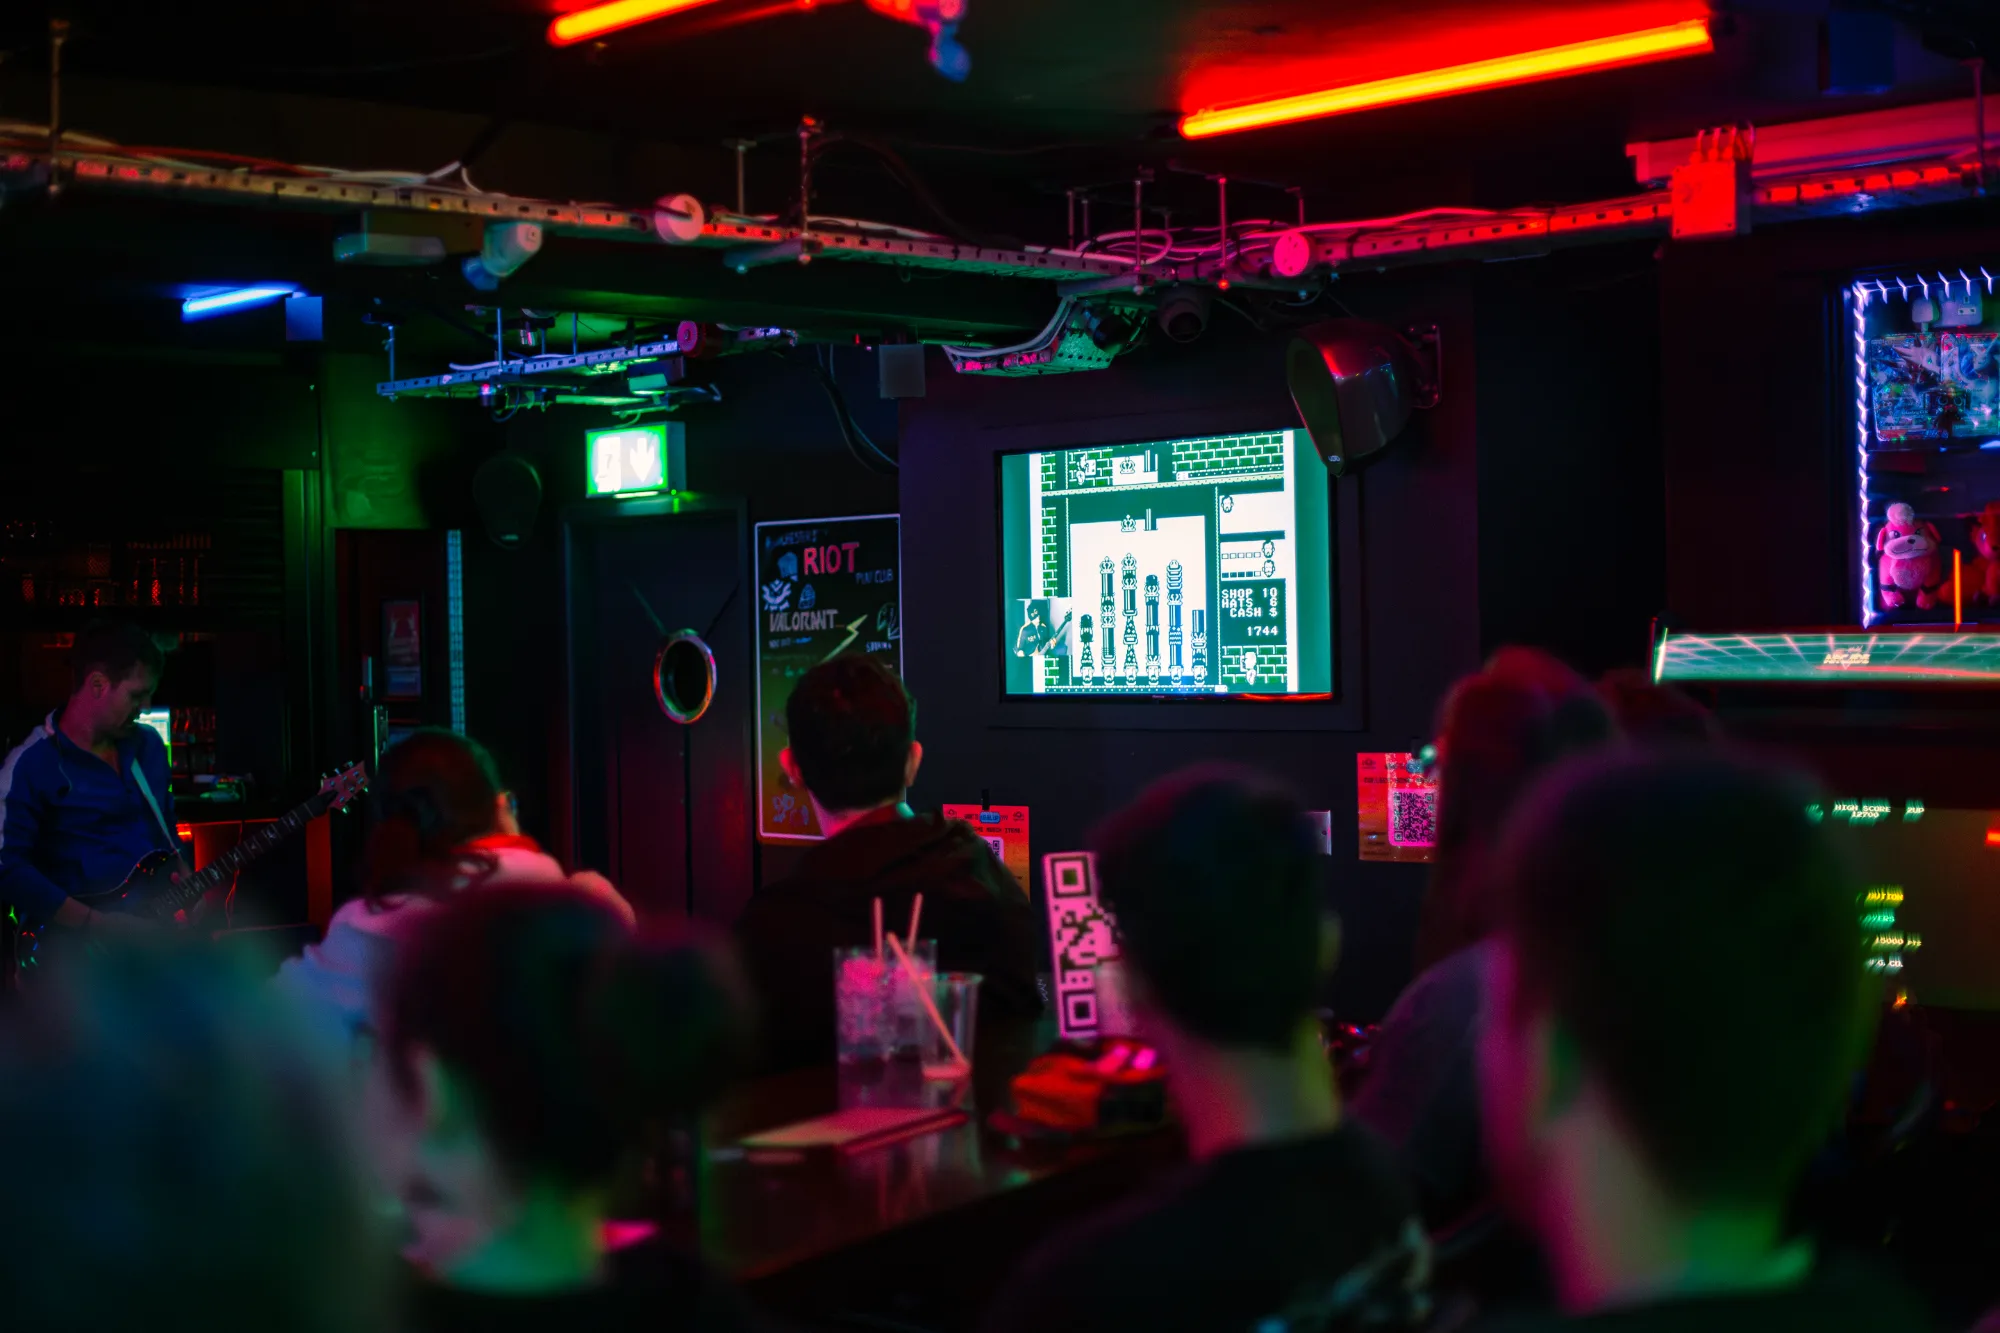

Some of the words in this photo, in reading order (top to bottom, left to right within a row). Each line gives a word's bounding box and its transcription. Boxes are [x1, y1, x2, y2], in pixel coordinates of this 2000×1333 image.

[803, 541, 860, 576] RIOT
[1221, 588, 1253, 599] SHOP
[1262, 587, 1278, 598] 10
[1221, 598, 1254, 609] HATS
[1229, 607, 1262, 618] CASH
[1269, 607, 1278, 617] $
[769, 609, 839, 633] VALORANT
[1247, 626, 1278, 636] 1744
[1833, 804, 1859, 812] HIGH
[1862, 805, 1891, 813] SCORE
